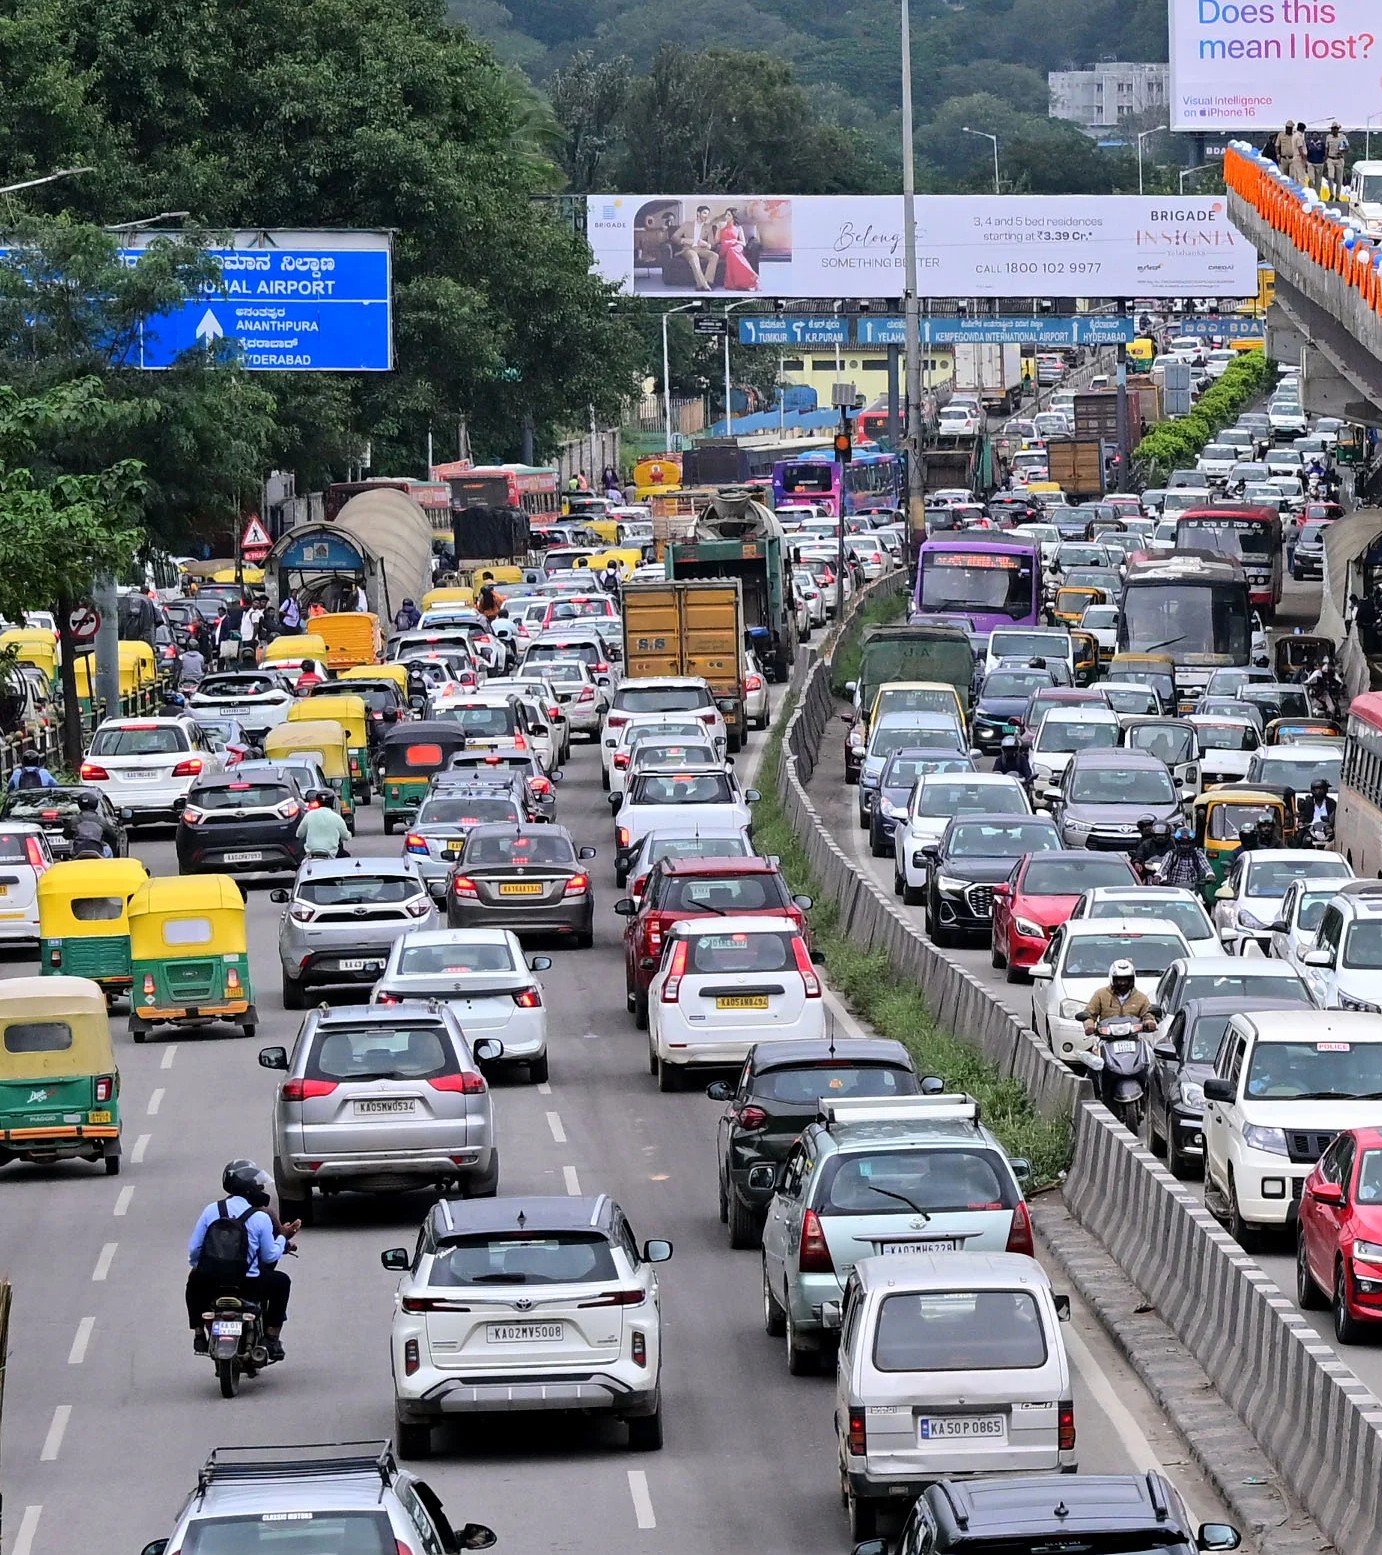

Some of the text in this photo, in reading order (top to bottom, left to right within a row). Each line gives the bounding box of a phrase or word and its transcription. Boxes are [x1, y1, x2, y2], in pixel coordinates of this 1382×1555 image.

[1199, 0, 1335, 24] Does this
[1199, 34, 1374, 59] mean I lost?
[1183, 95, 1272, 106] Visual Intelligence
[1184, 107, 1256, 117] on iPhone 16
[1151, 210, 1216, 221] BRIGADE
[974, 216, 1103, 227] 3, 4 and 5 bed residences
[833, 221, 902, 254] Belong
[983, 231, 1023, 243] starting
[1025, 231, 1035, 240] at
[1137, 229, 1234, 245] INSIGNIA
[821, 257, 940, 268] SOMETHING BTER
[975, 262, 1101, 273] CALL 1800 102 9977
[256, 280, 335, 295] AIRPORT
[236, 320, 319, 332] ANANTHPURA
[1229, 323, 1260, 333] BDA
[758, 332, 788, 342] TUMKUR
[878, 332, 907, 342] YELAHA
[935, 332, 1069, 342] KEMPEGOWDA INTERNATIONAL AIRPORT
[1083, 332, 1126, 342] HYDERABAD
[1319, 1042, 1349, 1050] POLICE
[360, 1101, 414, 1112] KA05MW0534
[494, 1327, 561, 1340] KA02MV5008
[262, 1512, 313, 1521] CLASSIC MOTORS
